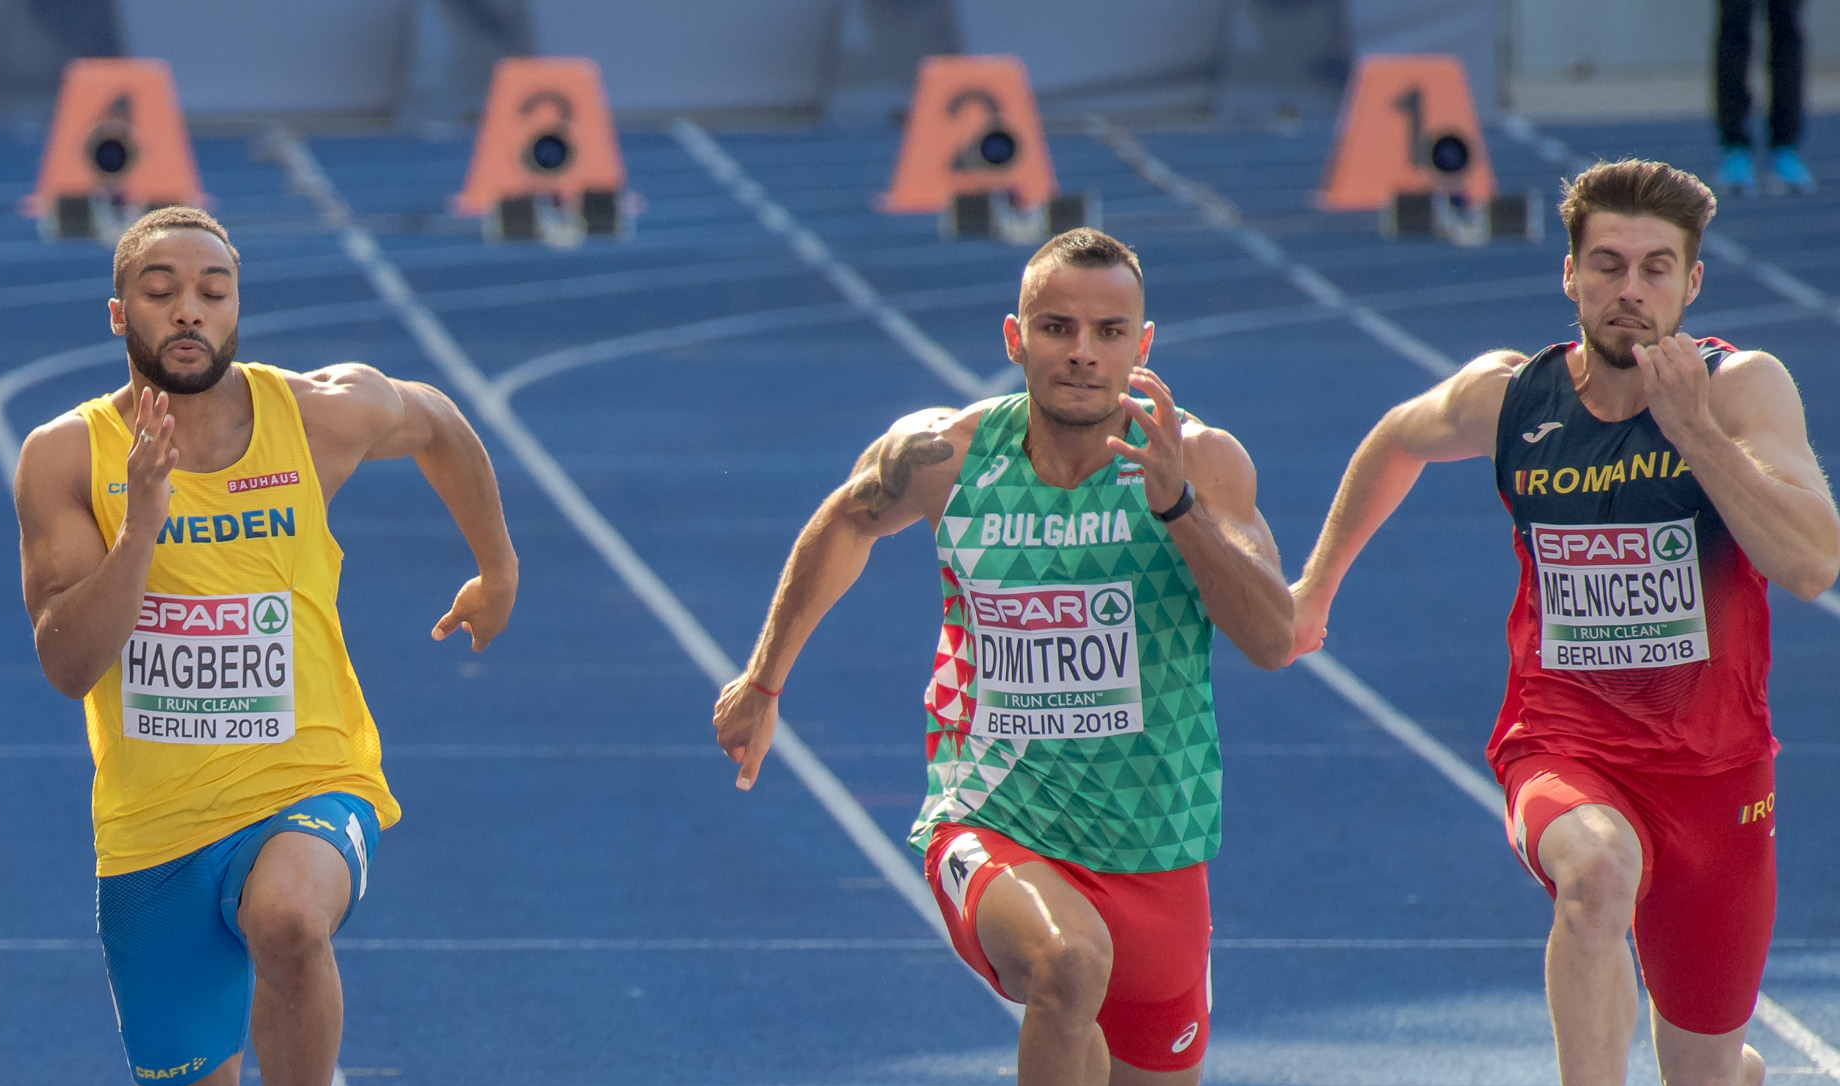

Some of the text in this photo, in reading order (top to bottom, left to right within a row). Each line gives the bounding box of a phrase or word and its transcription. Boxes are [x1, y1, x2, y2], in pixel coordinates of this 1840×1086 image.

[946, 89, 1013, 173] 2
[1392, 83, 1424, 168] 1
[228, 472, 299, 492] BAUHAUS
[156, 507, 296, 544] WEDEN
[980, 509, 1132, 547] BULGARIA
[1538, 532, 1646, 561] SPAR
[1543, 565, 1697, 617] MELNICESCU
[136, 601, 247, 632] SPAR
[974, 595, 1085, 626] SPAR
[1573, 627, 1577, 640] I
[1580, 627, 1611, 640] RUN
[128, 640, 287, 690] HAGBERG
[981, 632, 1129, 684] DIMITROV
[1557, 639, 1695, 665] BERLIN 2018
[157, 697, 162, 710] I
[166, 698, 198, 712] RUN
[1004, 693, 1008, 706] I
[1011, 694, 1043, 707] RUN
[138, 714, 280, 739] BERLIN 2018
[988, 710, 1130, 735] BERLIN 2018
[135, 1062, 191, 1080] CRAFT
